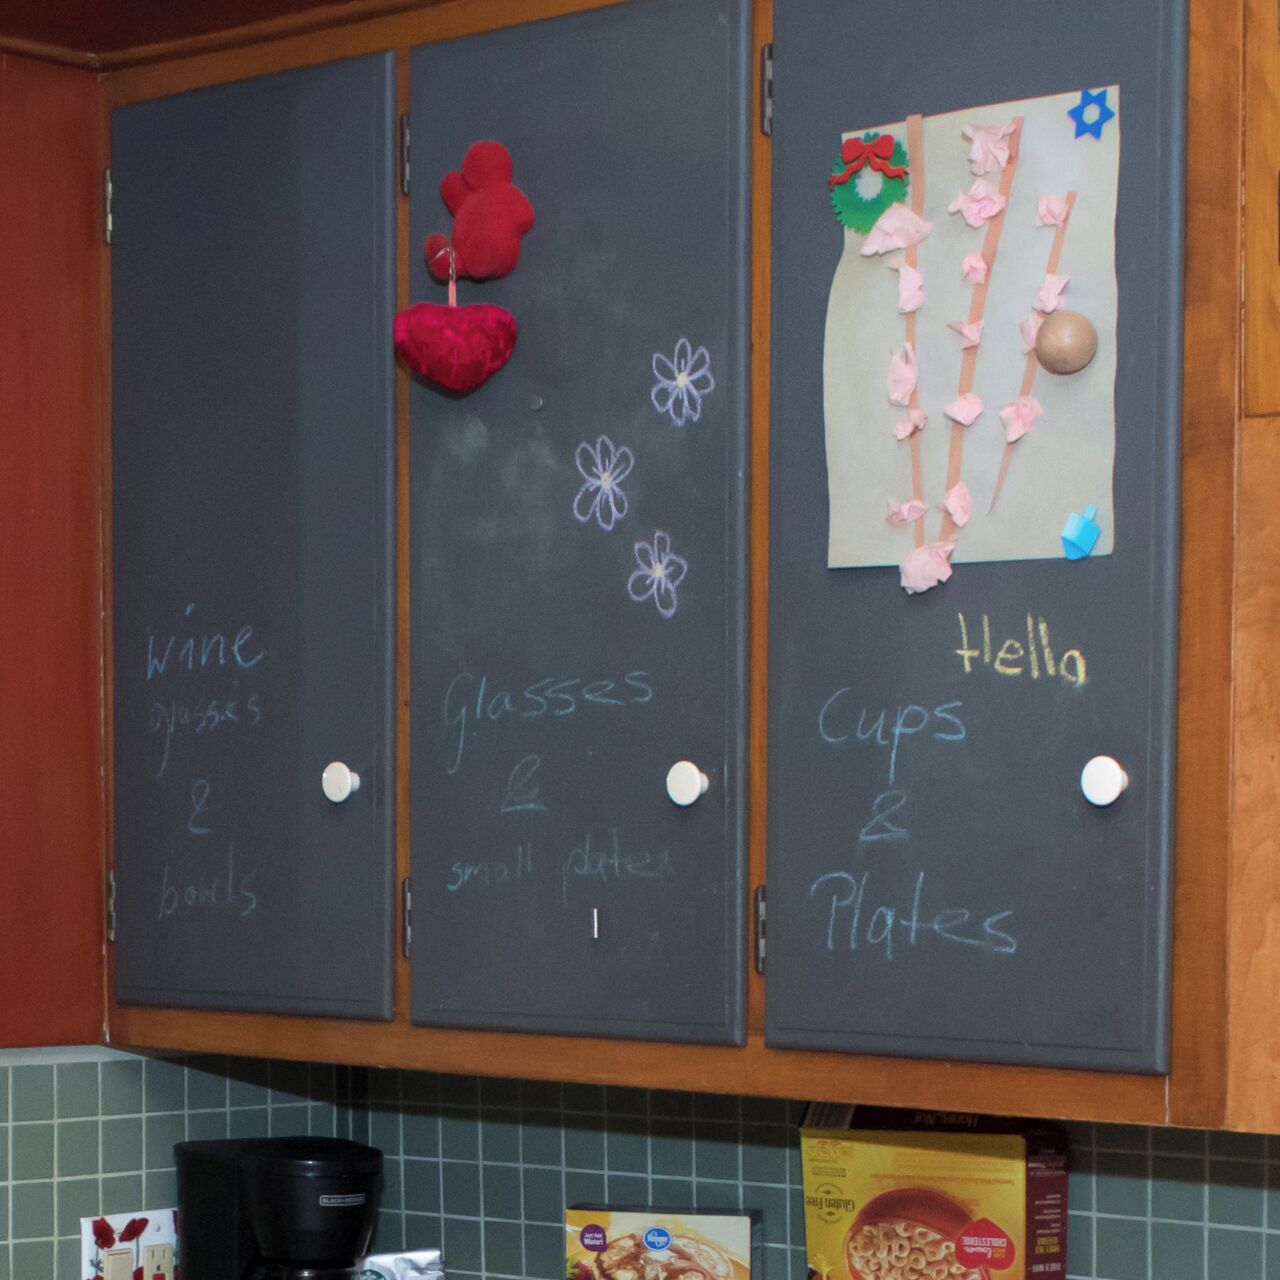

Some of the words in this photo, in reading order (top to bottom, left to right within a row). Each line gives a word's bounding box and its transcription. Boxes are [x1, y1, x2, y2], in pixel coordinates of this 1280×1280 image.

[818, 687, 968, 786] Cups
[810, 870, 1018, 961] Plates
[806, 1195, 825, 1210] Free
[825, 1196, 855, 1212] Gluten
